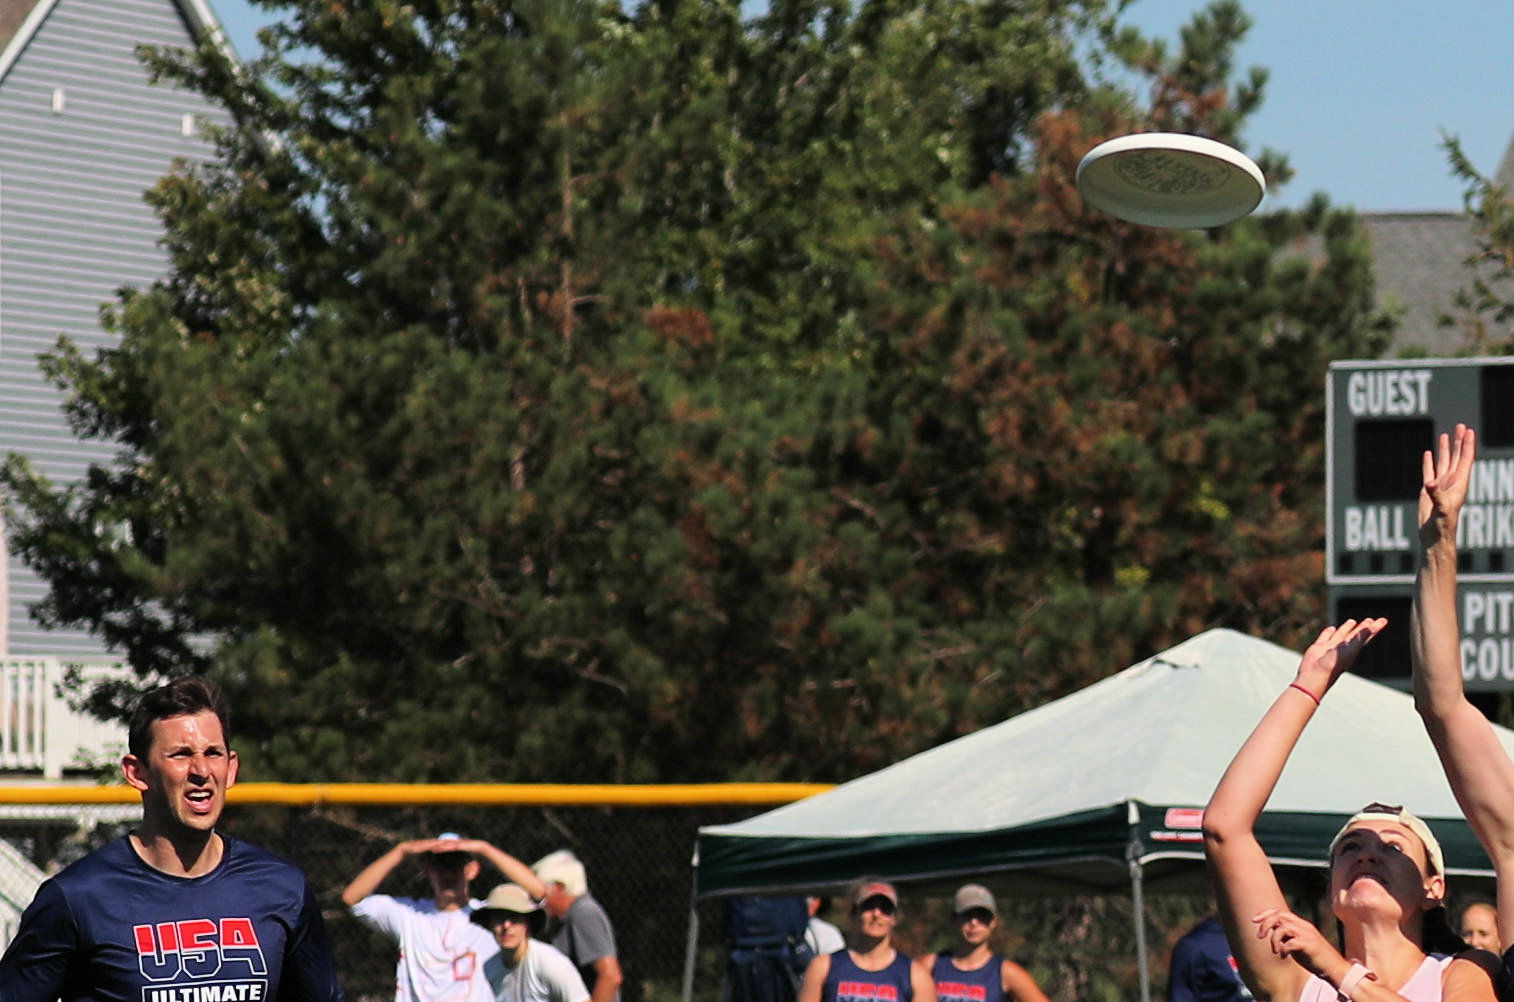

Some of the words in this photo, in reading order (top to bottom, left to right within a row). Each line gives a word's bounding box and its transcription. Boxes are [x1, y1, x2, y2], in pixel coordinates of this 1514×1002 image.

[1347, 370, 1432, 416] GUEST
[1345, 505, 1410, 551] BALL
[133, 917, 268, 982] USA
